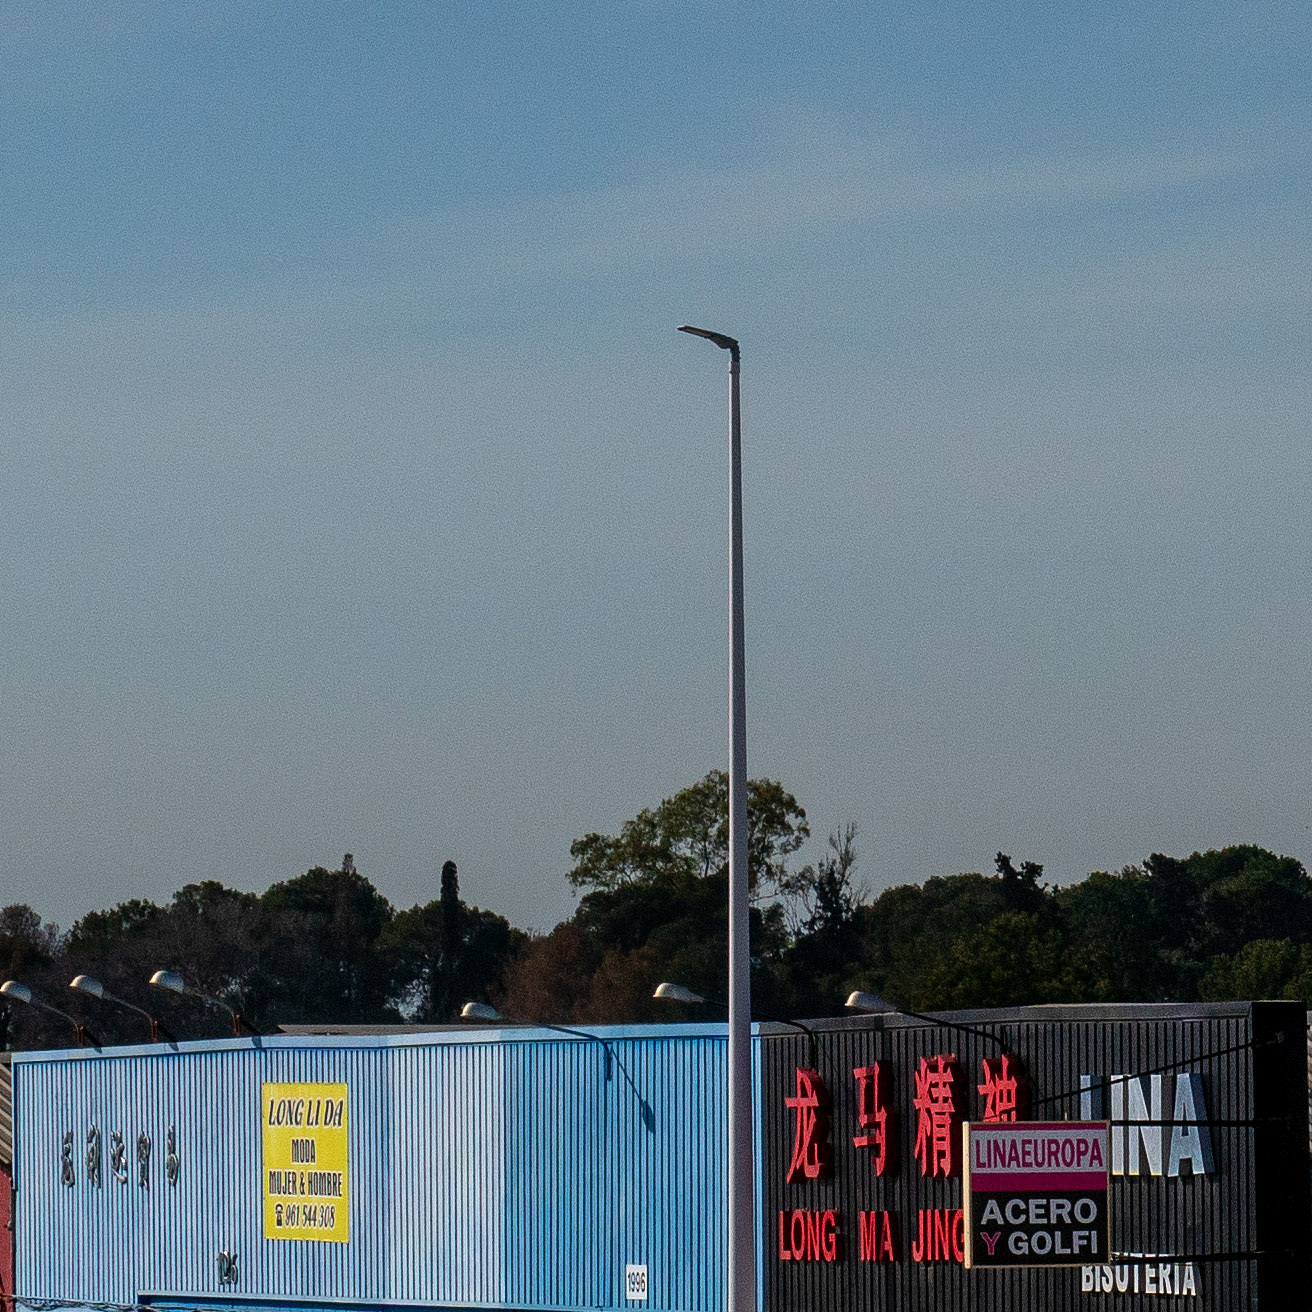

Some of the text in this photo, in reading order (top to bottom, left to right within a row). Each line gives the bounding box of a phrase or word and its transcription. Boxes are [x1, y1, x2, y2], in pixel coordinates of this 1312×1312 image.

[268, 1099, 343, 1127] LONG LI DA
[291, 1138, 316, 1163] MODA
[975, 1138, 1103, 1169] LINAEUROPA
[269, 1171, 297, 1195] MUJER
[307, 1172, 342, 1197] HOMBRE
[981, 1198, 1098, 1225] ACERO
[780, 1209, 836, 1261] LONG
[860, 1211, 894, 1261] MA
[981, 1230, 1098, 1256] Y GOLFI
